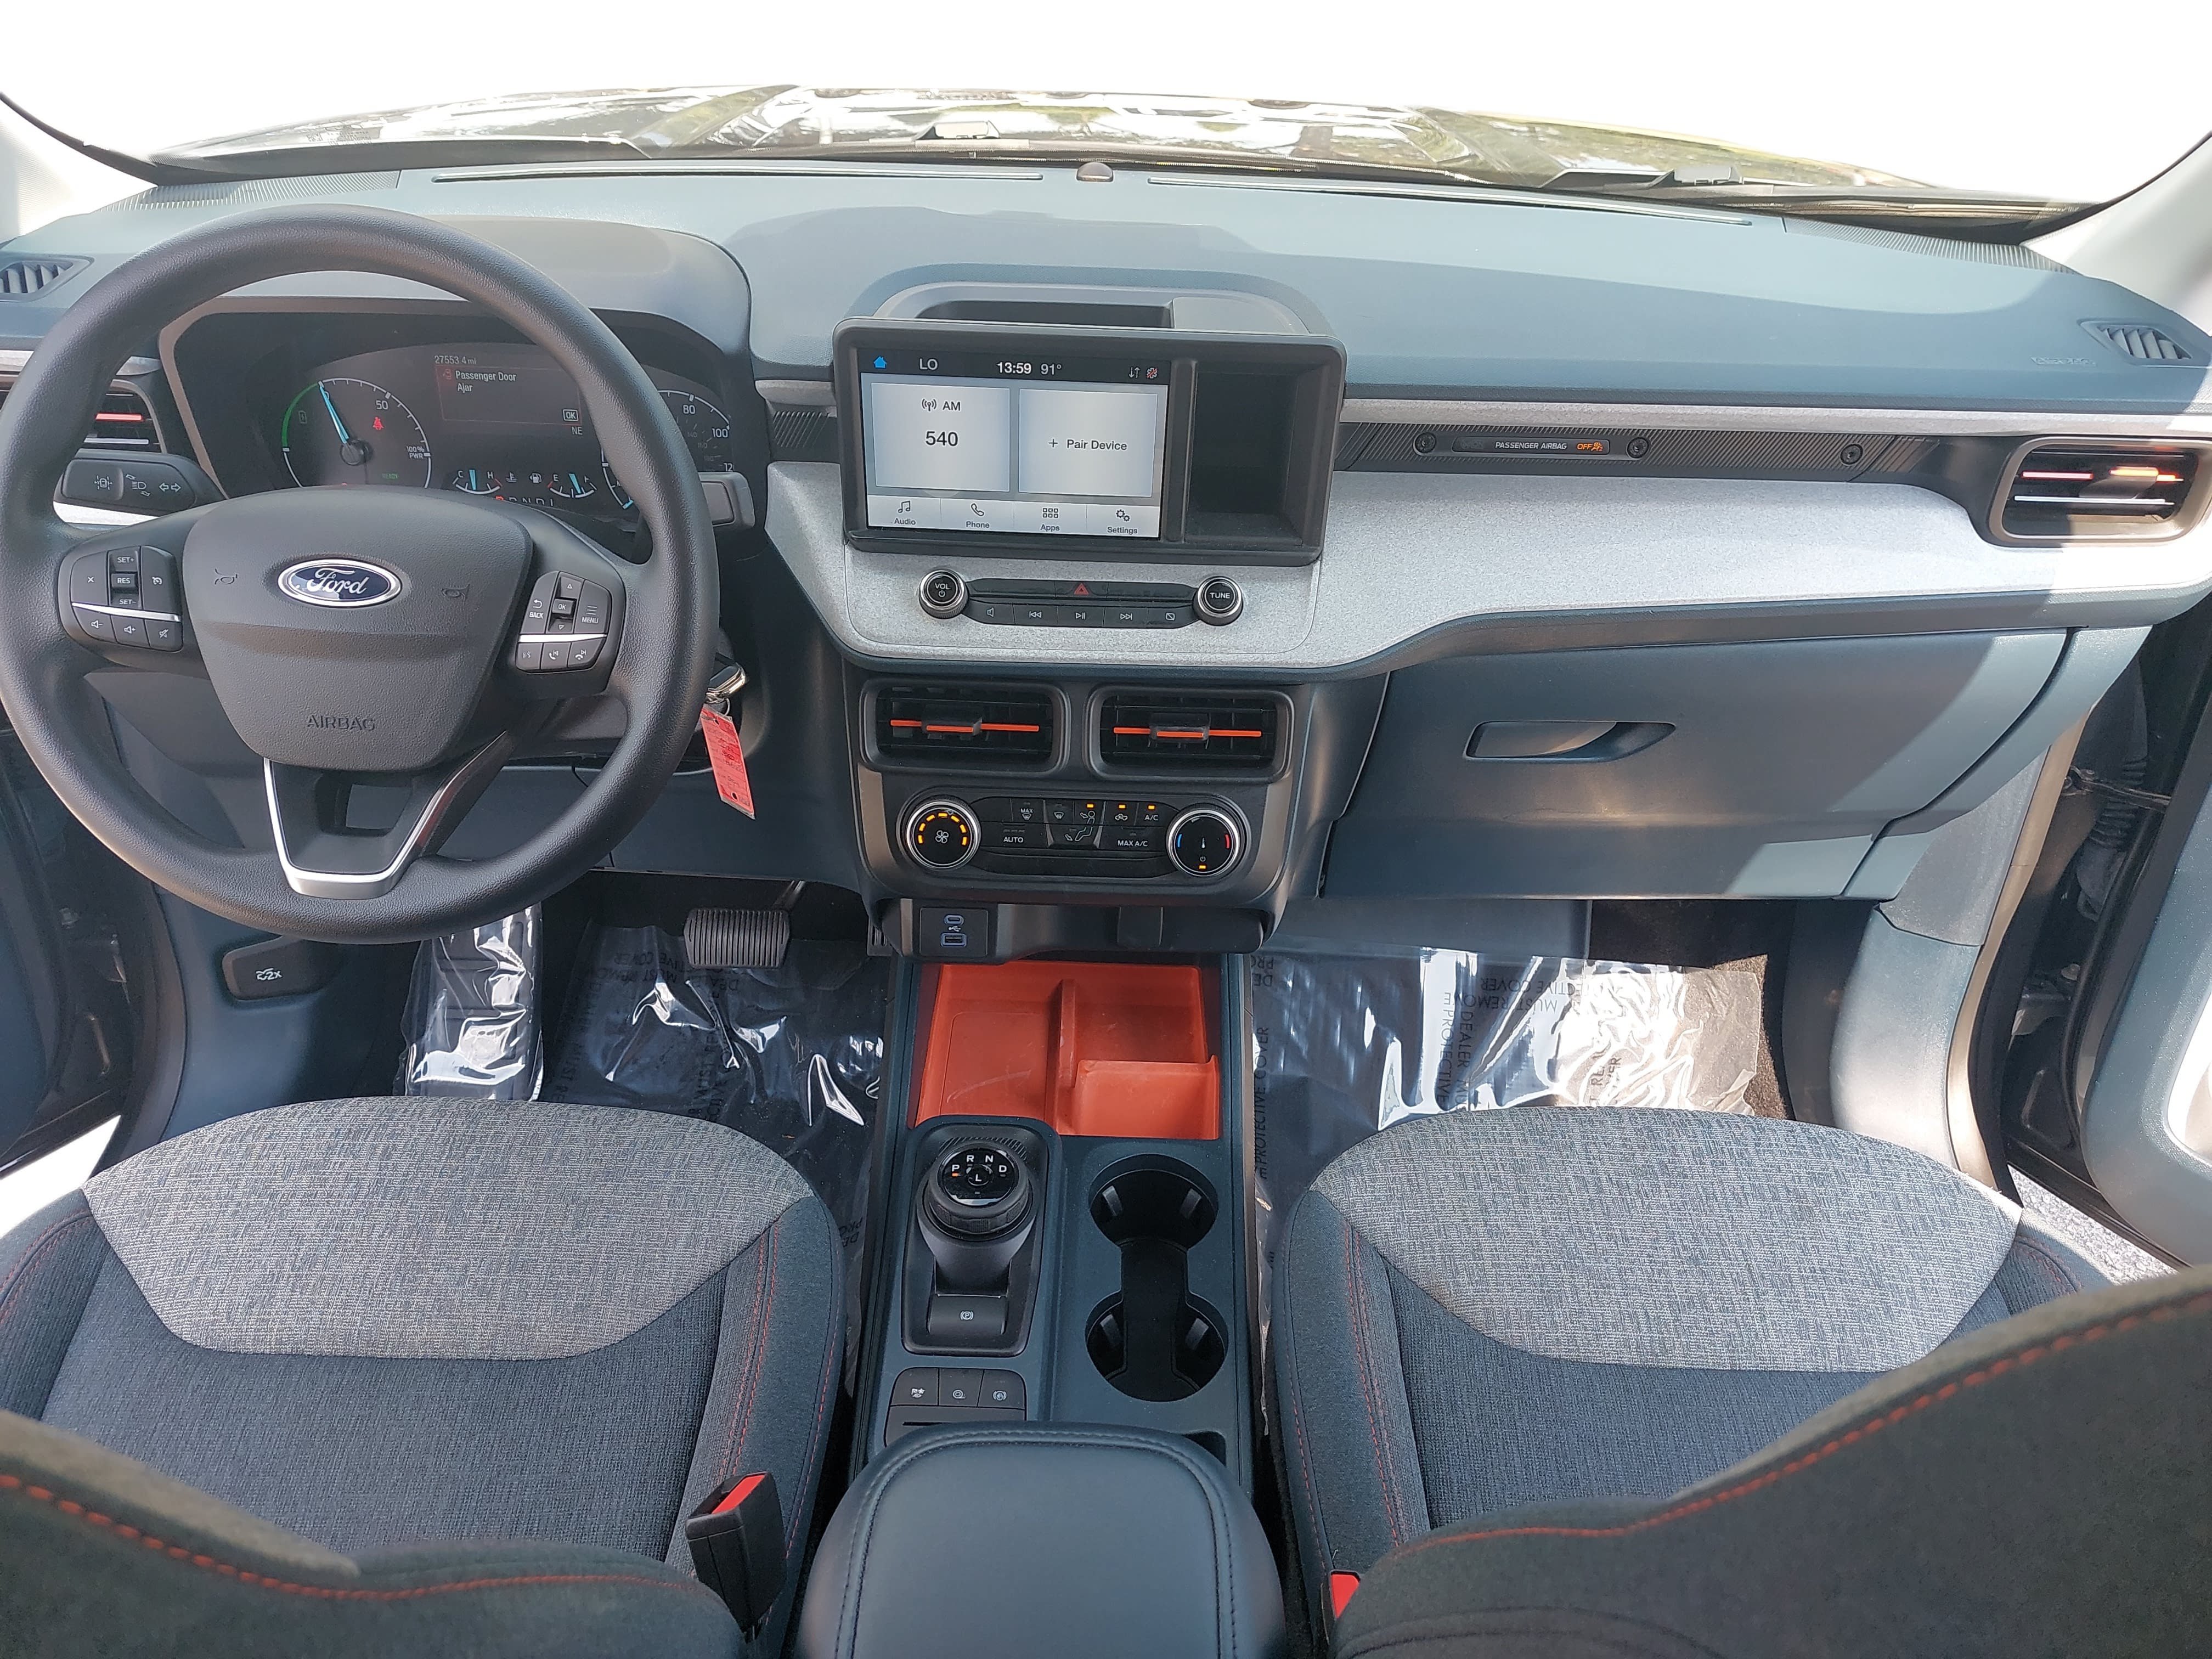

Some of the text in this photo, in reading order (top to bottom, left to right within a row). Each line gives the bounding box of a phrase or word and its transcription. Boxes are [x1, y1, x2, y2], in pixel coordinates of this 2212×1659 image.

[919, 358, 938, 370] LO
[996, 362, 1032, 375] 13:59
[1040, 364, 1062, 375] 91°
[455, 370, 517, 382] Passenger Door
[457, 383, 473, 394] Ajar
[376, 399, 389, 410] 50
[682, 404, 696, 414] 80
[943, 401, 961, 411] AM
[572, 426, 583, 435] NE
[712, 428, 728, 438] 100
[925, 431, 958, 447] 540
[1066, 439, 1127, 451] Pair Device
[1495, 441, 1538, 449] PASSENGER
[724, 462, 735, 472] 12
[966, 521, 990, 529] Phone
[1040, 524, 1060, 533] Apps
[1107, 526, 1138, 535] Settings
[307, 568, 370, 594] Ford
[529, 611, 544, 619] BACK
[307, 714, 375, 731] AIRBAG
[1482, 978, 1531, 993] COVER
[1516, 998, 1558, 1014] MUST
[1457, 1011, 1474, 1069] DEALER
[1254, 1027, 1269, 1079] COVER
[1436, 1009, 1454, 1103] PROTECTIVE
[1255, 1086, 1267, 1166] PROTECTIVE
[975, 1173, 982, 1182] L
